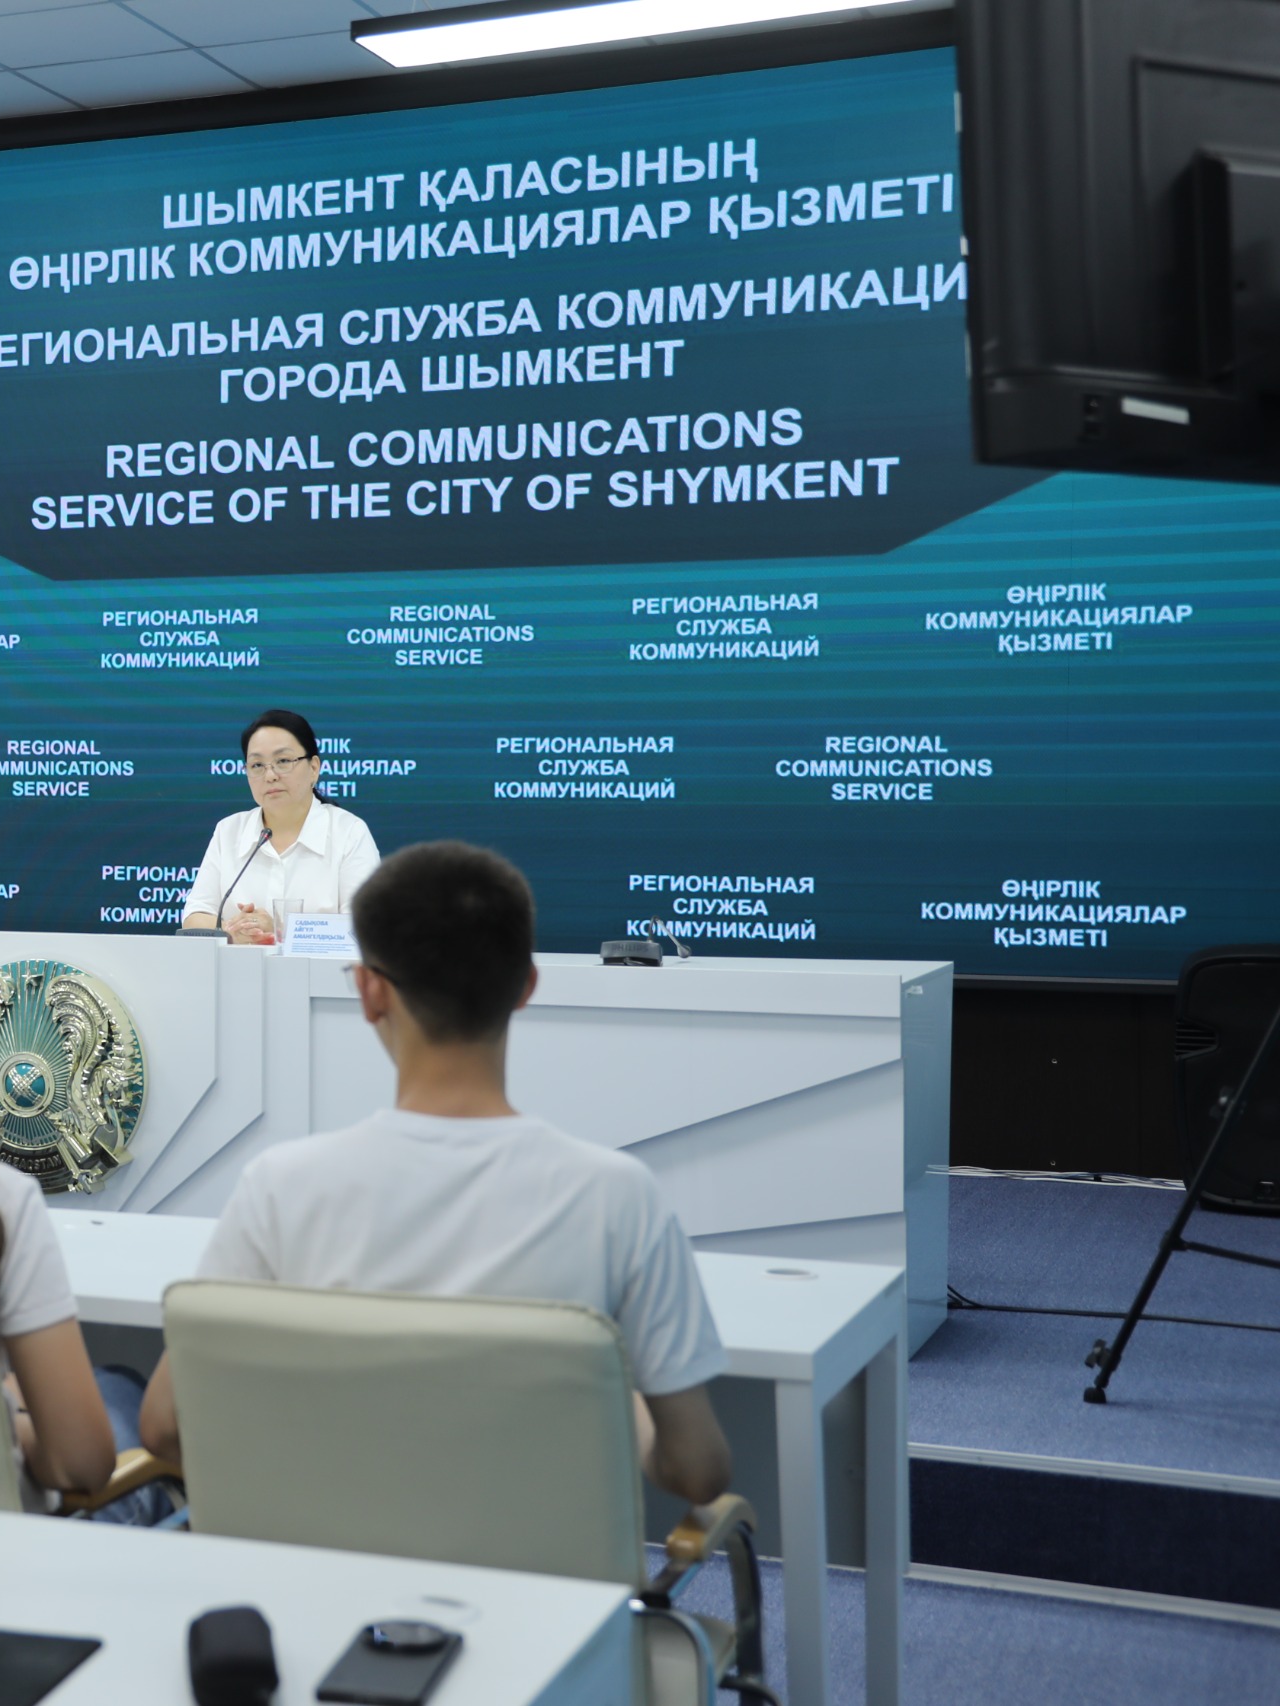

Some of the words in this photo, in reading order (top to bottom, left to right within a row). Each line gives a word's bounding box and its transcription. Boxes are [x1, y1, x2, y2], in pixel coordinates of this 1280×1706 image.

[163, 173, 405, 229] ШЫМКЕНТ
[419, 138, 759, 212] ҚАЛАСЫНЫҢ
[9, 244, 176, 293] ӨҢІРЛІК
[189, 200, 691, 277] КОММУНИКАЦИЯЛАР
[709, 173, 954, 238] ҚЫЗМЕТІ
[339, 297, 542, 346] СЛУЖБА
[558, 261, 967, 331] КОММУНИКАЦИ
[220, 359, 407, 404] ГОРОДА
[421, 339, 685, 392] ШЫМКЕНТ
[106, 435, 335, 479] REGIONAL
[348, 407, 803, 468] COMMUNICATIONS
[31, 489, 214, 530] SERVICE
[228, 486, 288, 523] OF
[301, 482, 391, 520] THE
[406, 476, 513, 516] CITY
[526, 473, 592, 511] OF
[607, 456, 900, 508] SHYMKENT
[632, 592, 818, 615] РЕГИОНАЛЬНАЯ
[1006, 583, 1106, 606] ӨҢІРЛІК
[102, 607, 259, 627] РЕГИОНАЛЬНАЯ
[389, 603, 496, 622] REGIONAL
[925, 604, 1193, 630] КОММУНИКАЦИЯЛАР
[346, 624, 535, 645] COMMUNICATIONS
[675, 617, 772, 637] СЛУЖБА
[139, 630, 220, 647] СЛУЖБА
[629, 636, 819, 661] КОММУНИКАЦИЙ
[998, 631, 1113, 656] ҚЫЗМЕТІ
[100, 646, 260, 670] КОММУНИКАЦИЙ
[395, 648, 483, 666] SERVICE
[7, 739, 101, 756] REGIONAL
[496, 736, 674, 754] РЕГИОНАЛЬНАЯ
[825, 735, 948, 754] REGIONAL
[538, 759, 630, 776] СЛУЖБА
[775, 758, 993, 777] COMMUNICATIONS
[12, 780, 90, 797] SERVICE
[494, 777, 675, 802] КОММУНИКАЦИЙ
[831, 782, 933, 801] SERVICE
[139, 887, 191, 902] СЛУЖ
[629, 874, 814, 894] РЕГИОНАЛЬНАЯ
[1001, 879, 1100, 901] ӨҢІРЛІК
[101, 906, 184, 923] КОММУН
[672, 897, 768, 916] СЛУЖБА
[921, 902, 1187, 926] КОММУНИКАЦИЯЛАР
[626, 918, 816, 944] КОММУНИКАЦИЙ
[994, 927, 1107, 948] ҚЫЗМЕТІ
